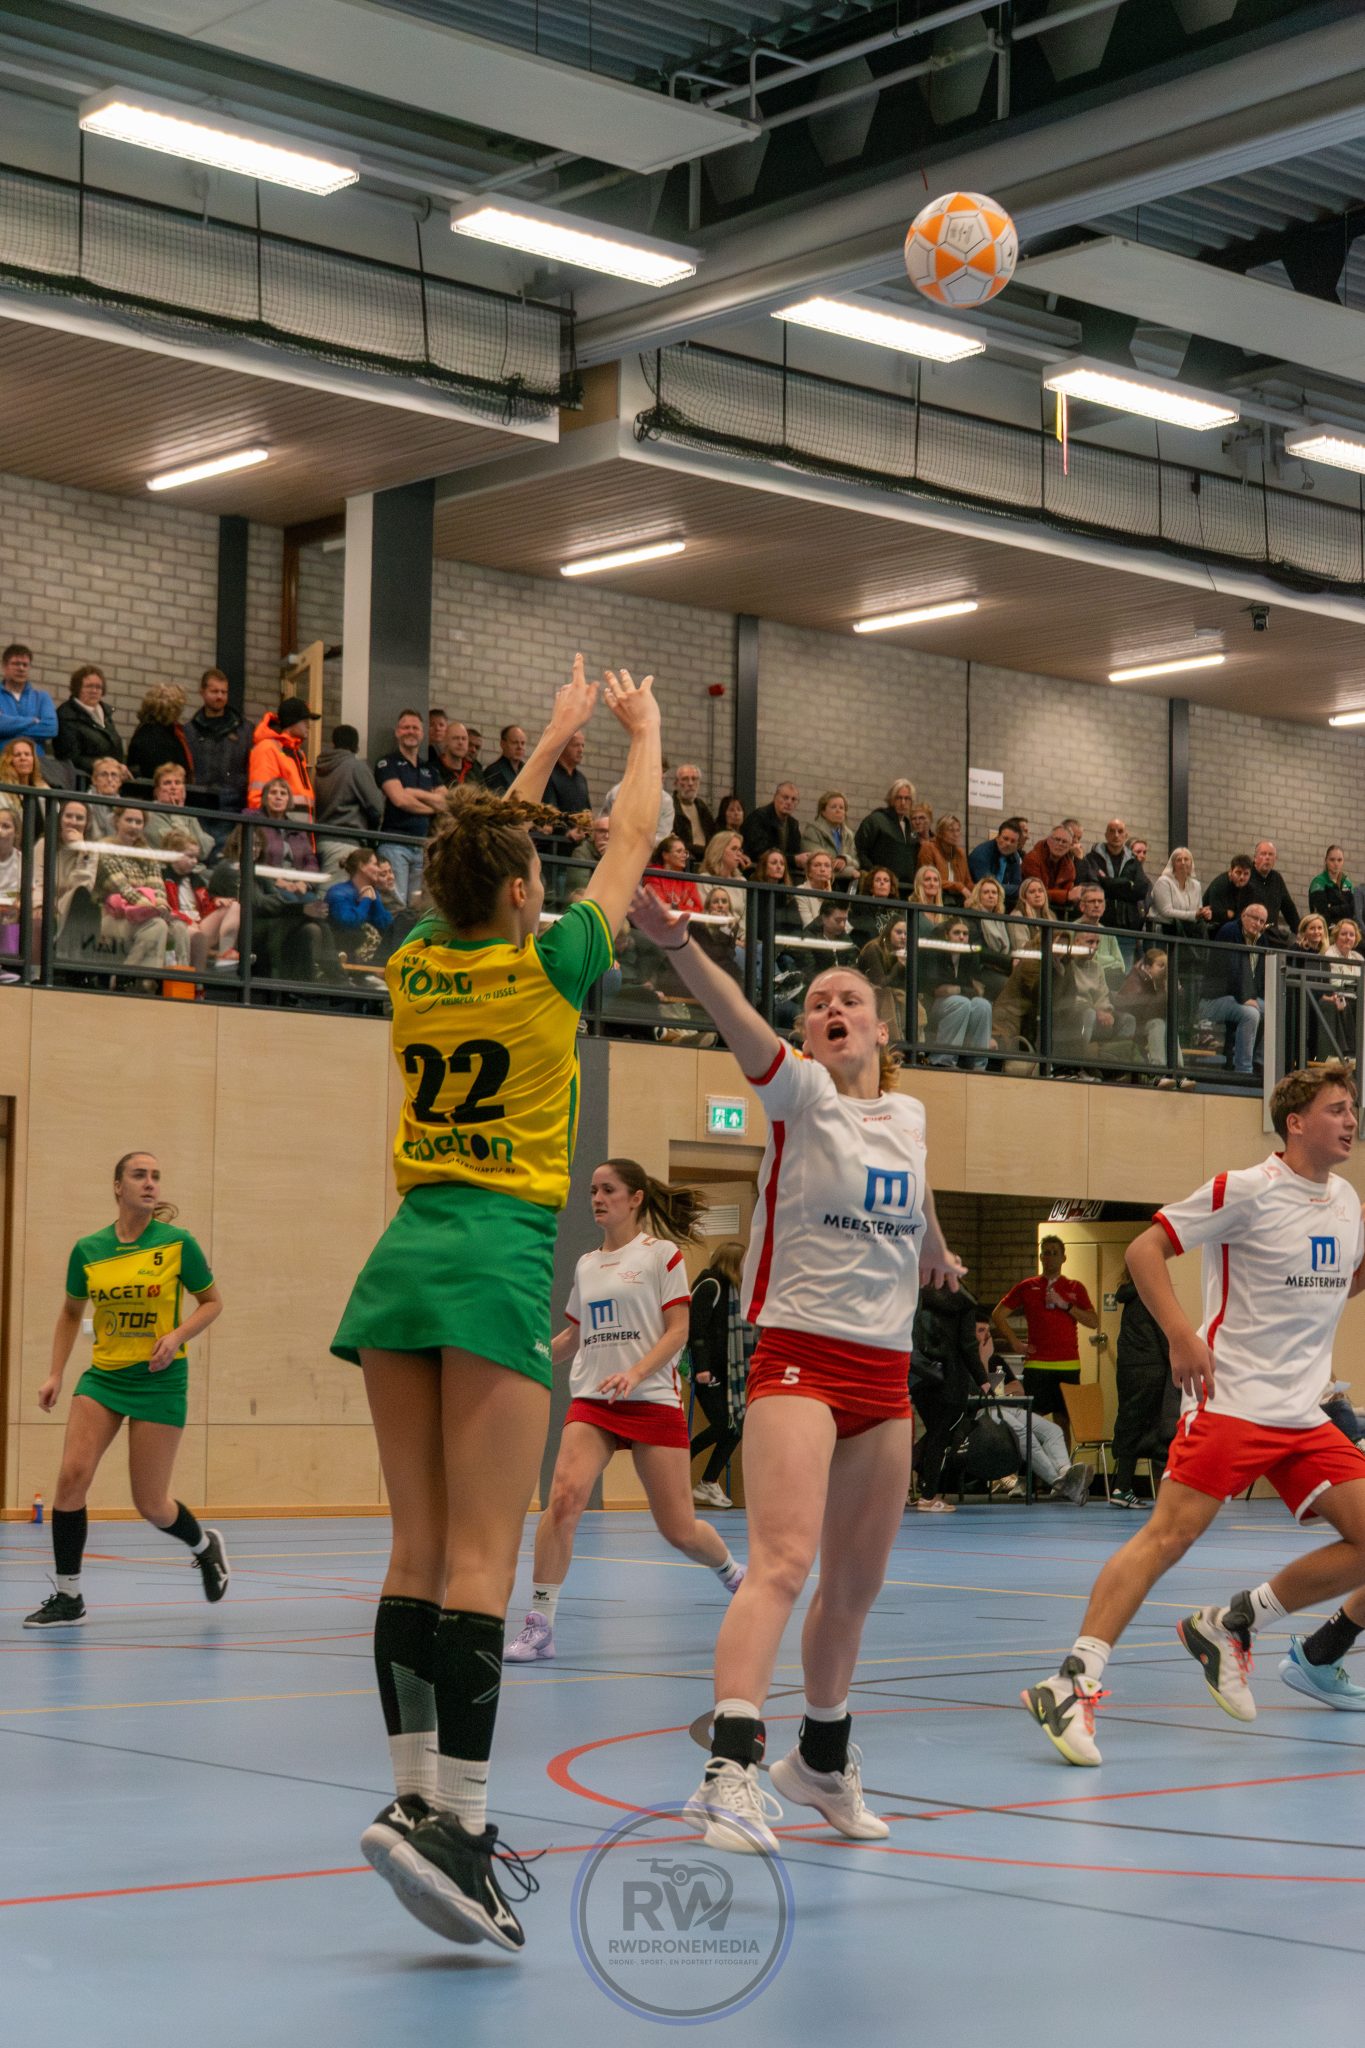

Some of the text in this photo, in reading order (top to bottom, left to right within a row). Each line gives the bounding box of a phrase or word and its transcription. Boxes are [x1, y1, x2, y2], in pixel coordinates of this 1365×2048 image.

[402, 1038, 511, 1124] 22
[153, 1252, 163, 1266] 5
[90, 1285, 145, 1302] FACET
[118, 1311, 158, 1329] TOP
[780, 1366, 801, 1385] 5
